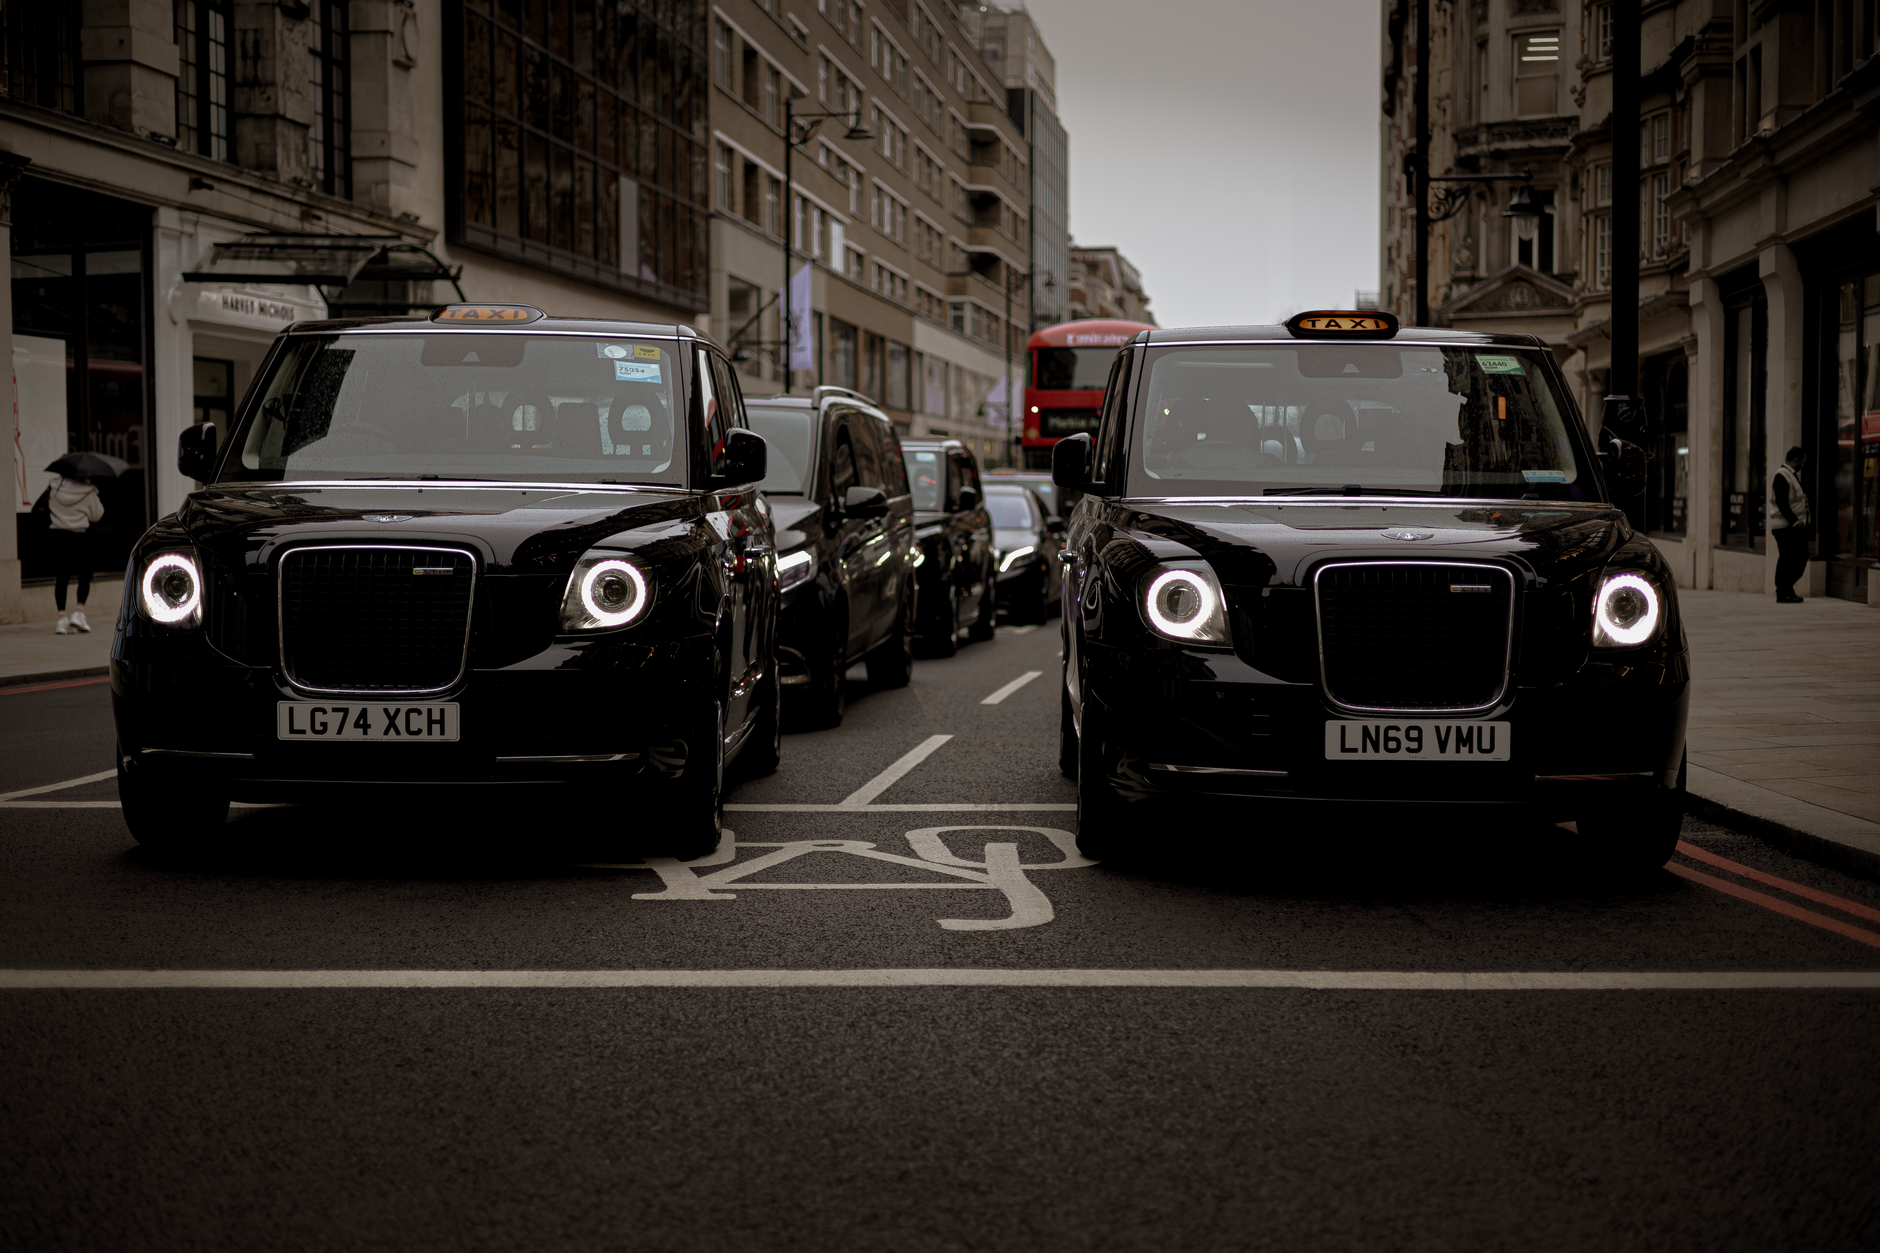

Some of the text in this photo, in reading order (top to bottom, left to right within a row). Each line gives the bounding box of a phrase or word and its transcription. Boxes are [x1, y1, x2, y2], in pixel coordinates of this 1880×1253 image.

[448, 309, 520, 319] TAXI
[1307, 319, 1381, 329] TAXI
[288, 706, 445, 736] LG74 XCH
[1340, 725, 1496, 754] LN69 VMU
